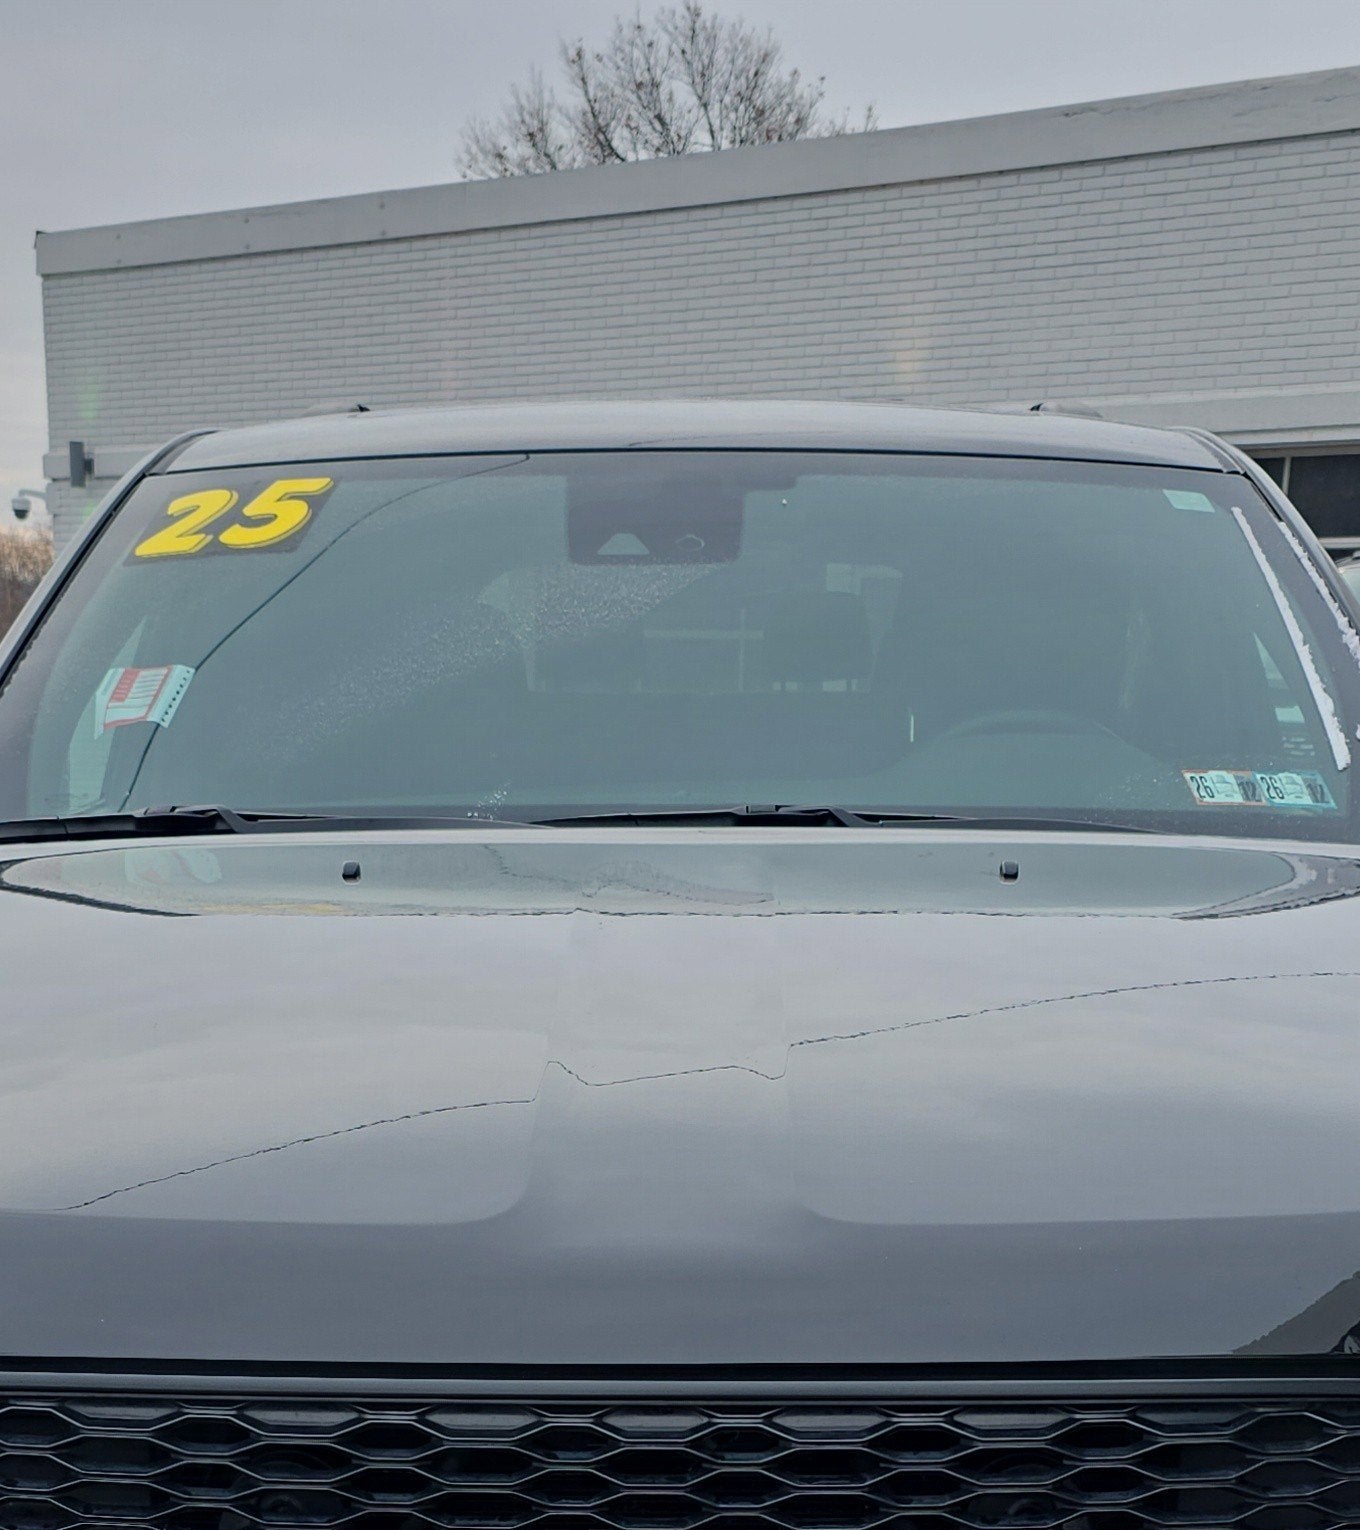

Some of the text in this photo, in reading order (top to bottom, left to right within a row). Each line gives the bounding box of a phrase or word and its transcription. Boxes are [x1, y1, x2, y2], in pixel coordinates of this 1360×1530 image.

[135, 477, 334, 557] 25
[1190, 775, 1215, 799] 26
[1260, 776, 1285, 800] 26
